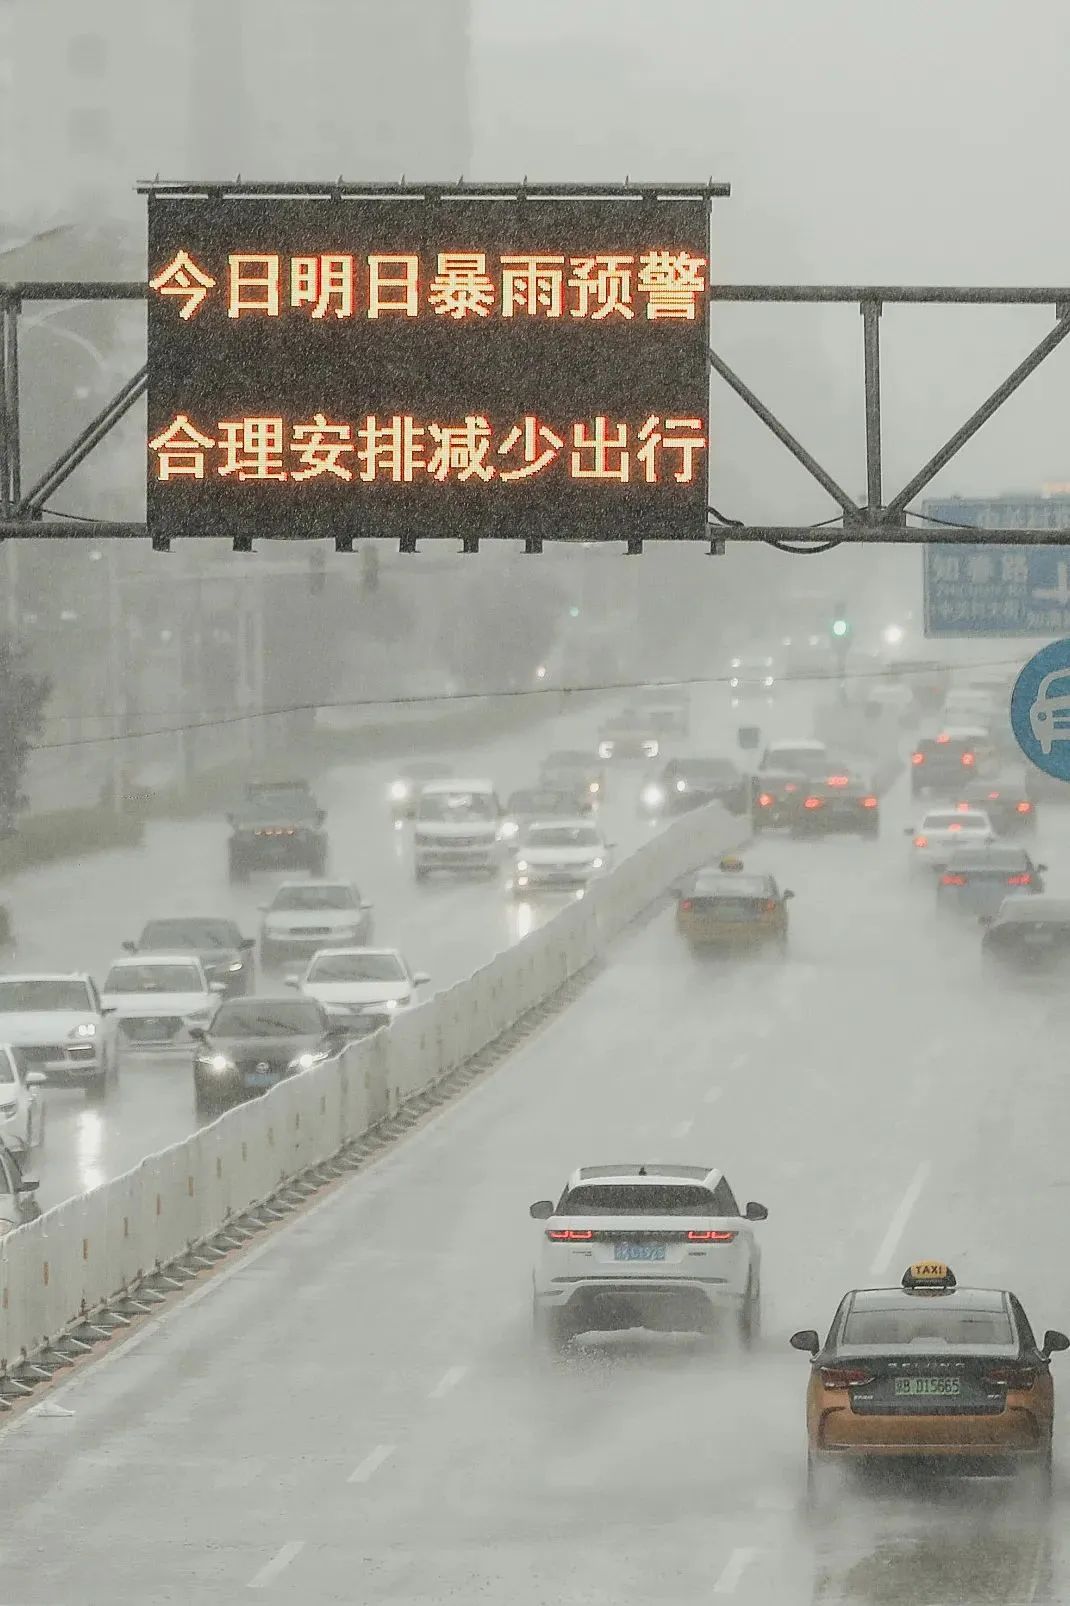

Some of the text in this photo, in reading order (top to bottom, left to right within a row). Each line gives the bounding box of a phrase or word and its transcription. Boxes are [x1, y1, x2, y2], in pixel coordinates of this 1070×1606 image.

[149, 250, 707, 320] 今日明日暴雨预警
[149, 413, 707, 483] 合理安排减少出行
[916, 1265, 942, 1275] TAXI
